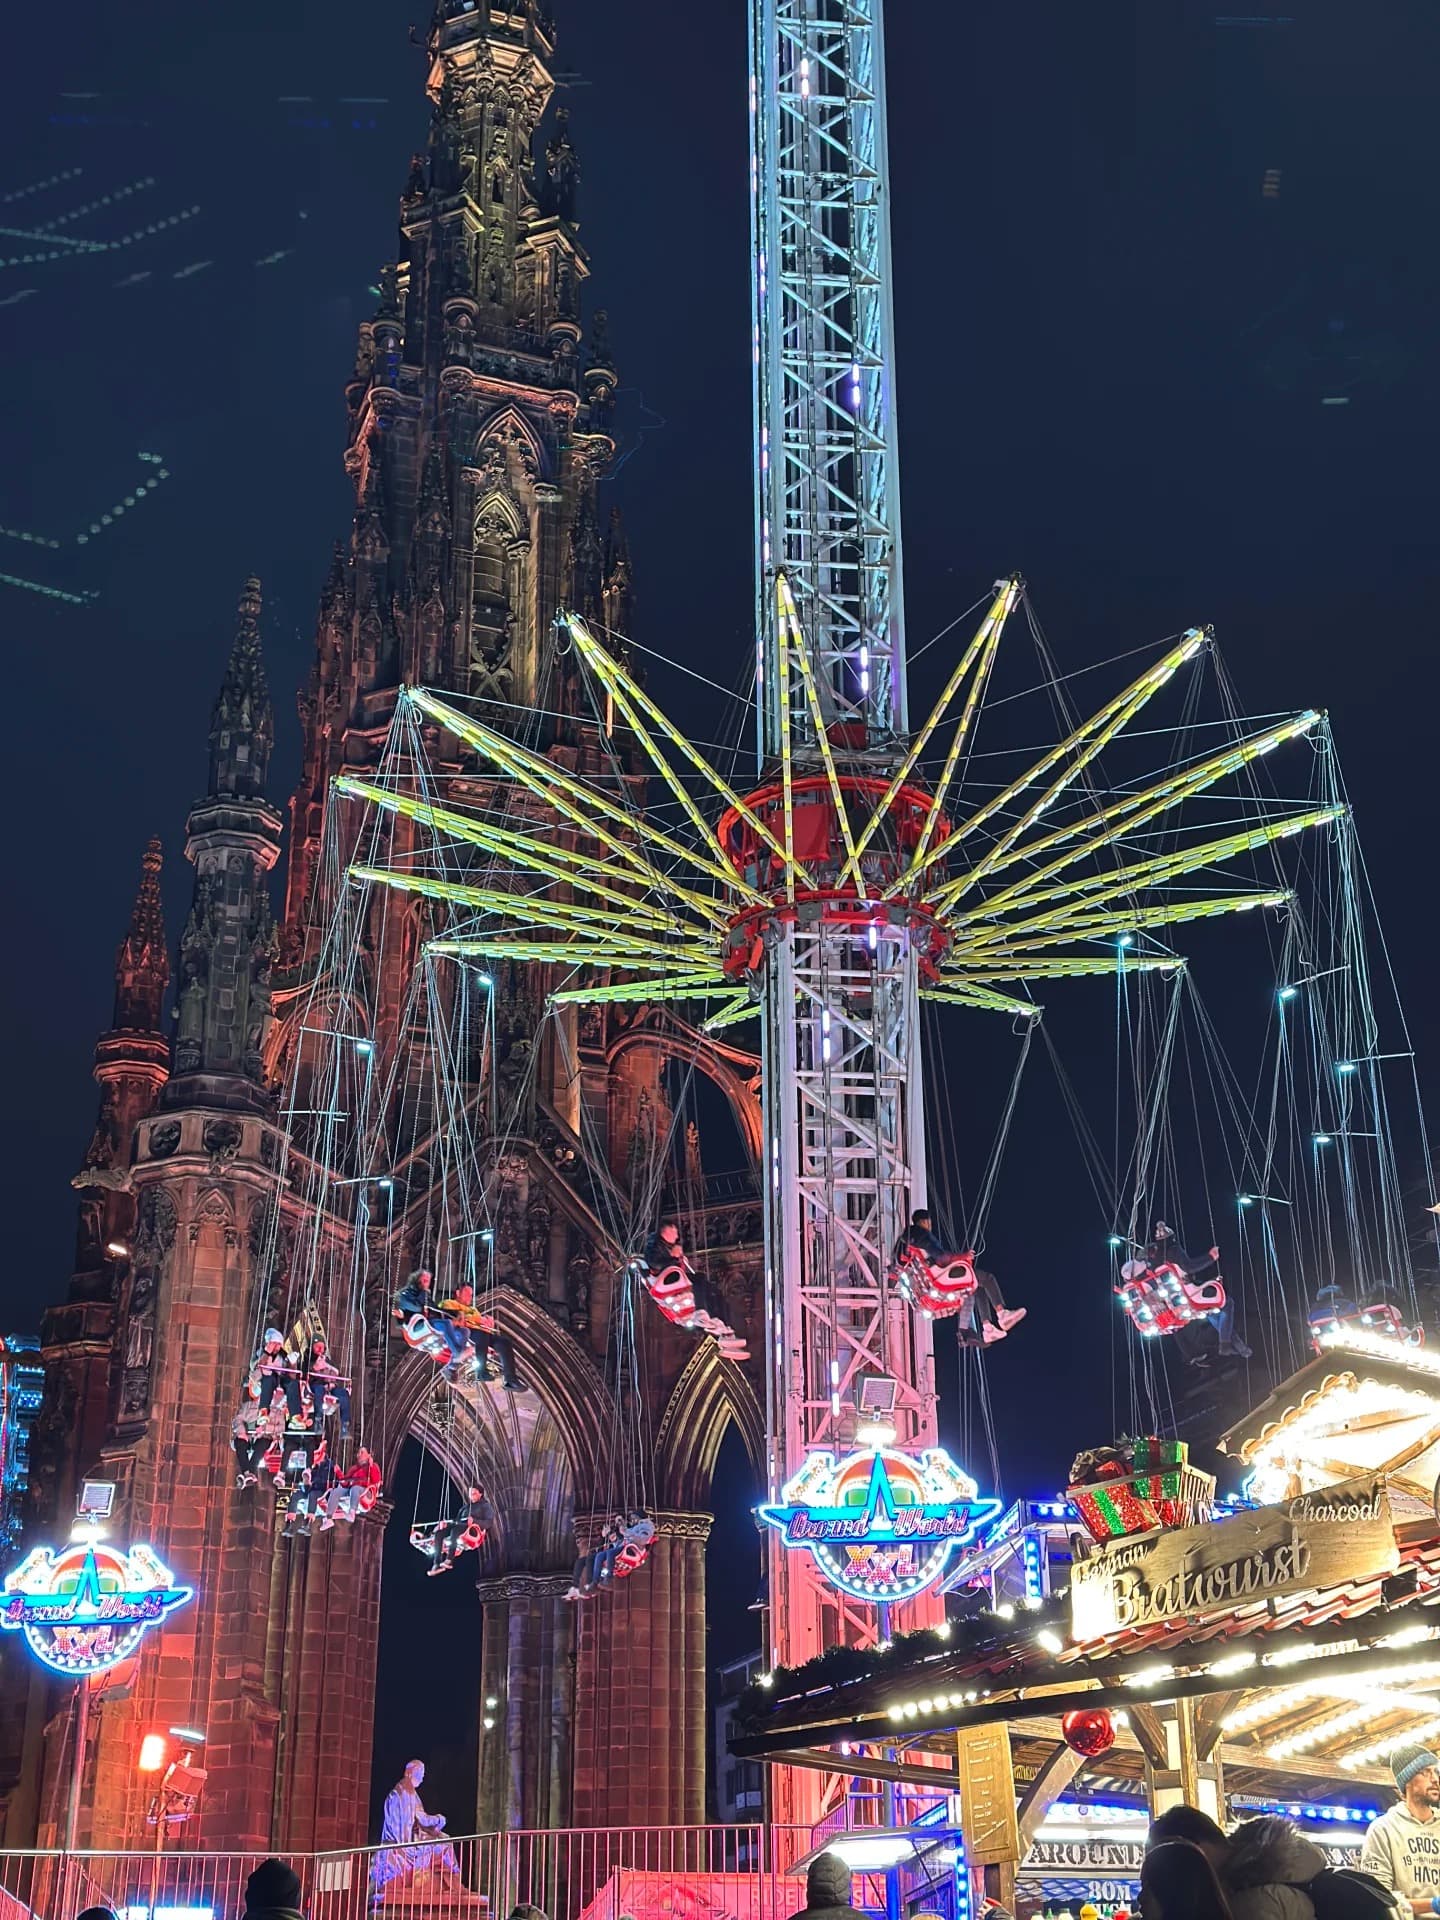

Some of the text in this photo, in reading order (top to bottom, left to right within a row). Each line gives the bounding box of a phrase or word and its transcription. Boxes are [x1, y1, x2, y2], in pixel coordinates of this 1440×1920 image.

[893, 1507, 968, 1537] World
[1288, 1494, 1381, 1522] Charcoal
[844, 1543, 920, 1586] XXL
[1105, 1526, 1311, 1626] Bratwurst
[49, 1625, 116, 1661] XXL
[1413, 1866, 1440, 1886] HAC
